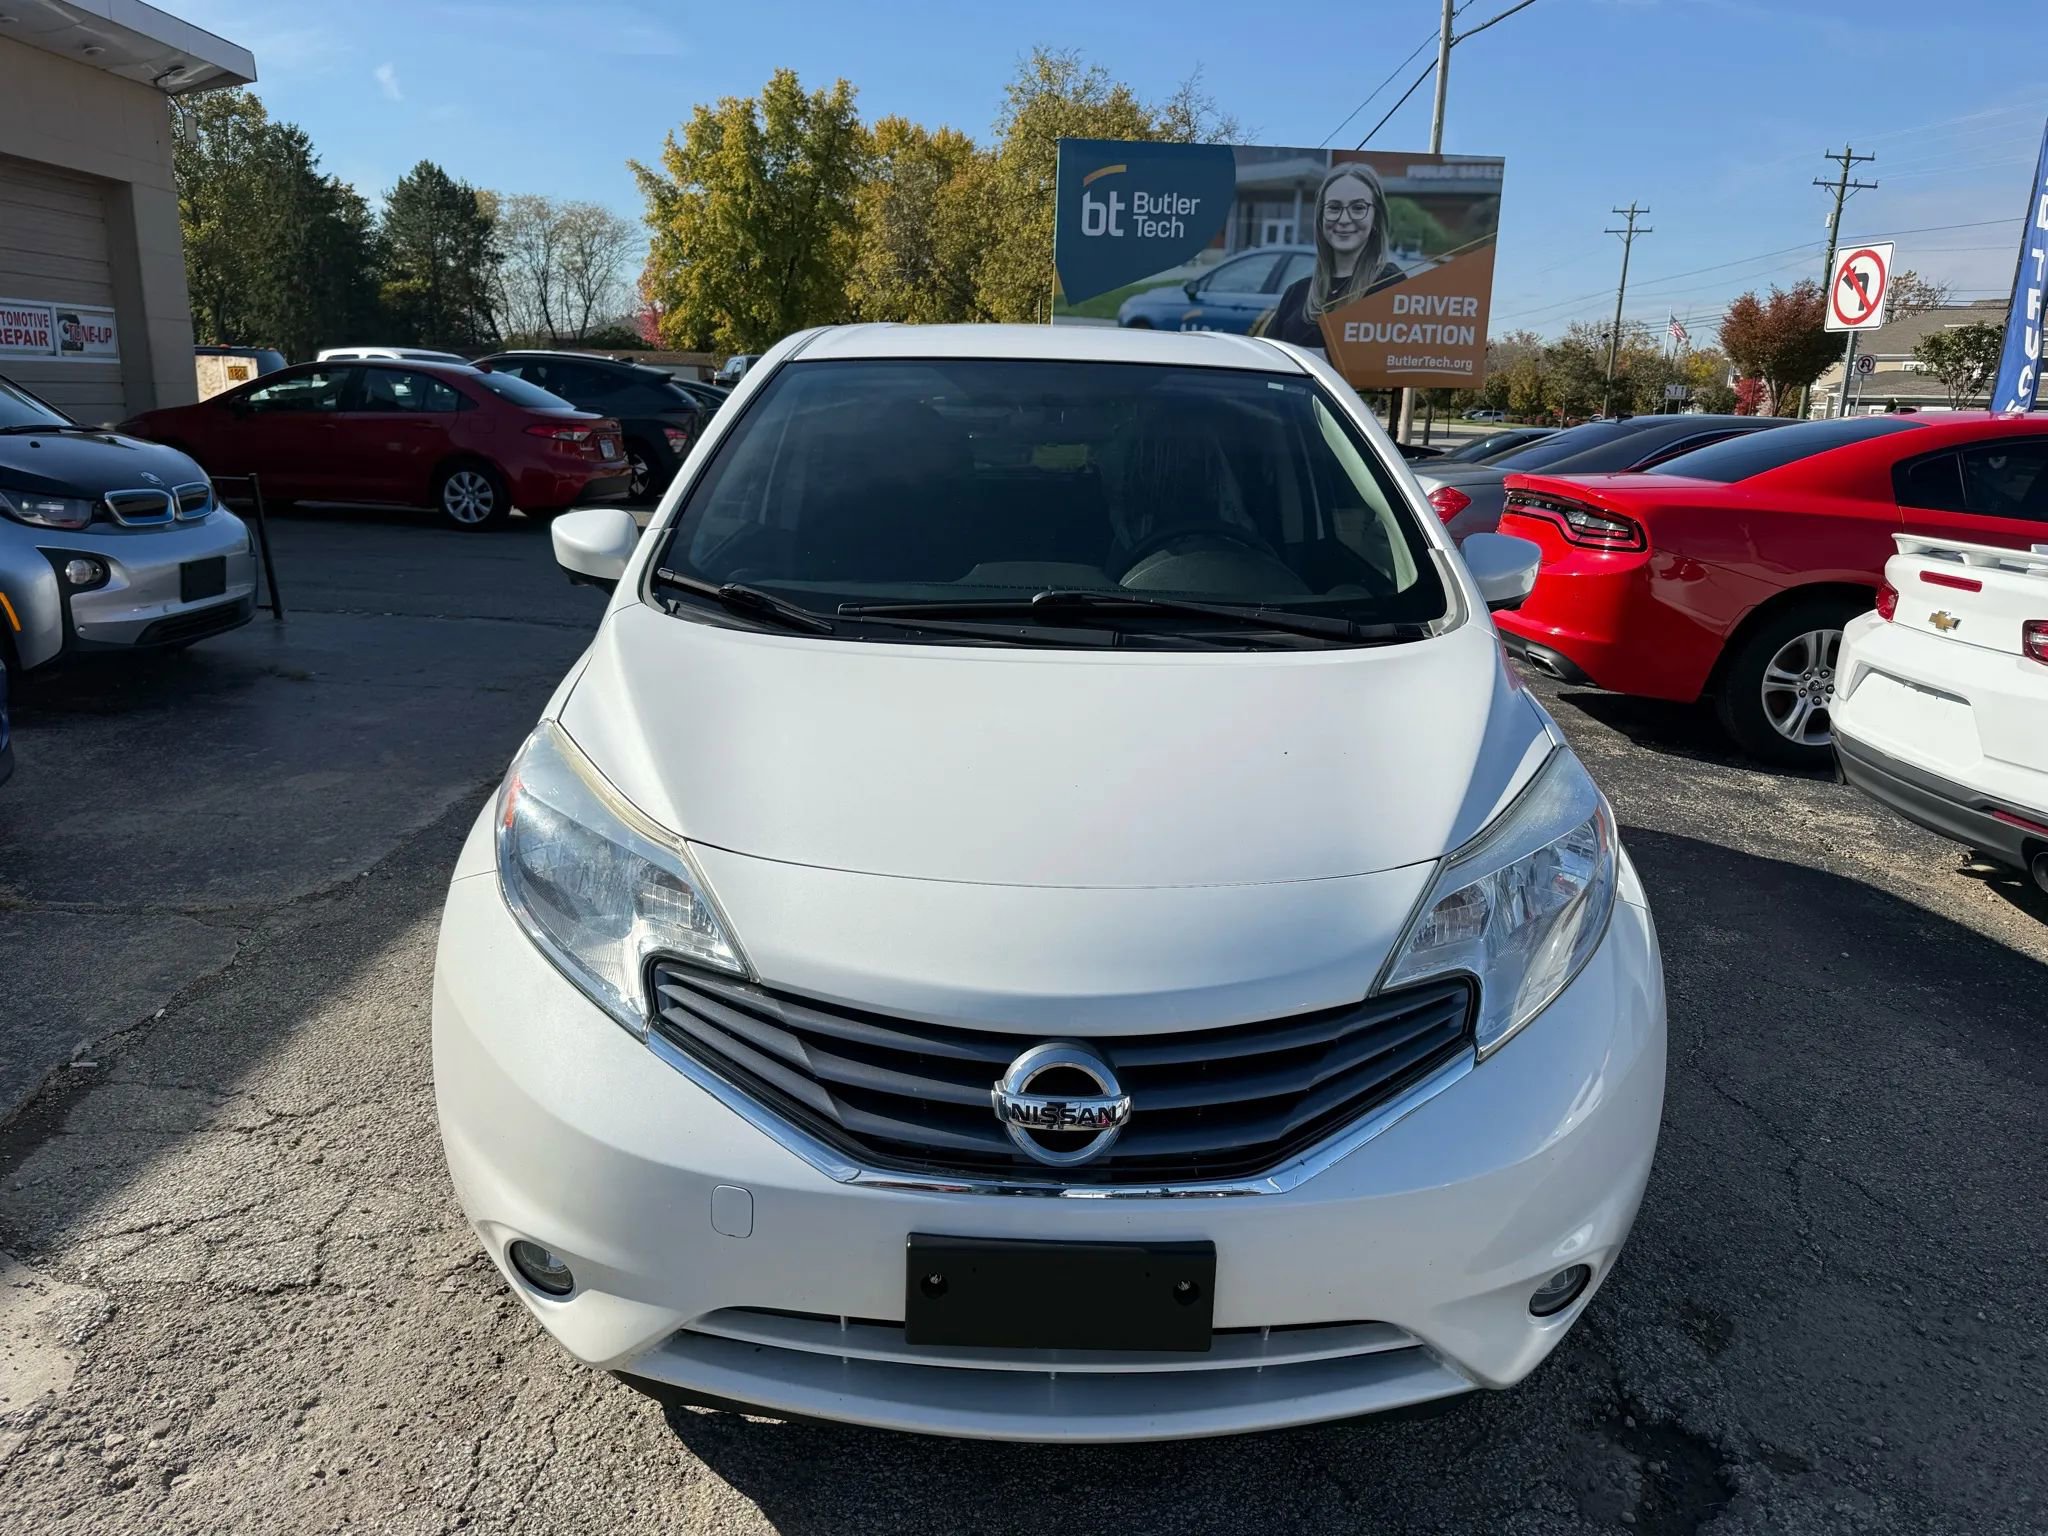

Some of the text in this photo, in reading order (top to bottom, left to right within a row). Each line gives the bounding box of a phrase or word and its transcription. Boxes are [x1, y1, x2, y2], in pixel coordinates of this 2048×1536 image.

[1081, 190, 1125, 237] bt
[1133, 191, 1200, 215] Butler
[1133, 215, 1185, 238] Tech
[1392, 294, 1478, 317] DRIVER
[68, 323, 112, 344] TUNE-UP
[1343, 322, 1475, 346] EDUCATION
[1386, 354, 1473, 371] ButlerTech.org
[1011, 1102, 1117, 1125] NISSAN
